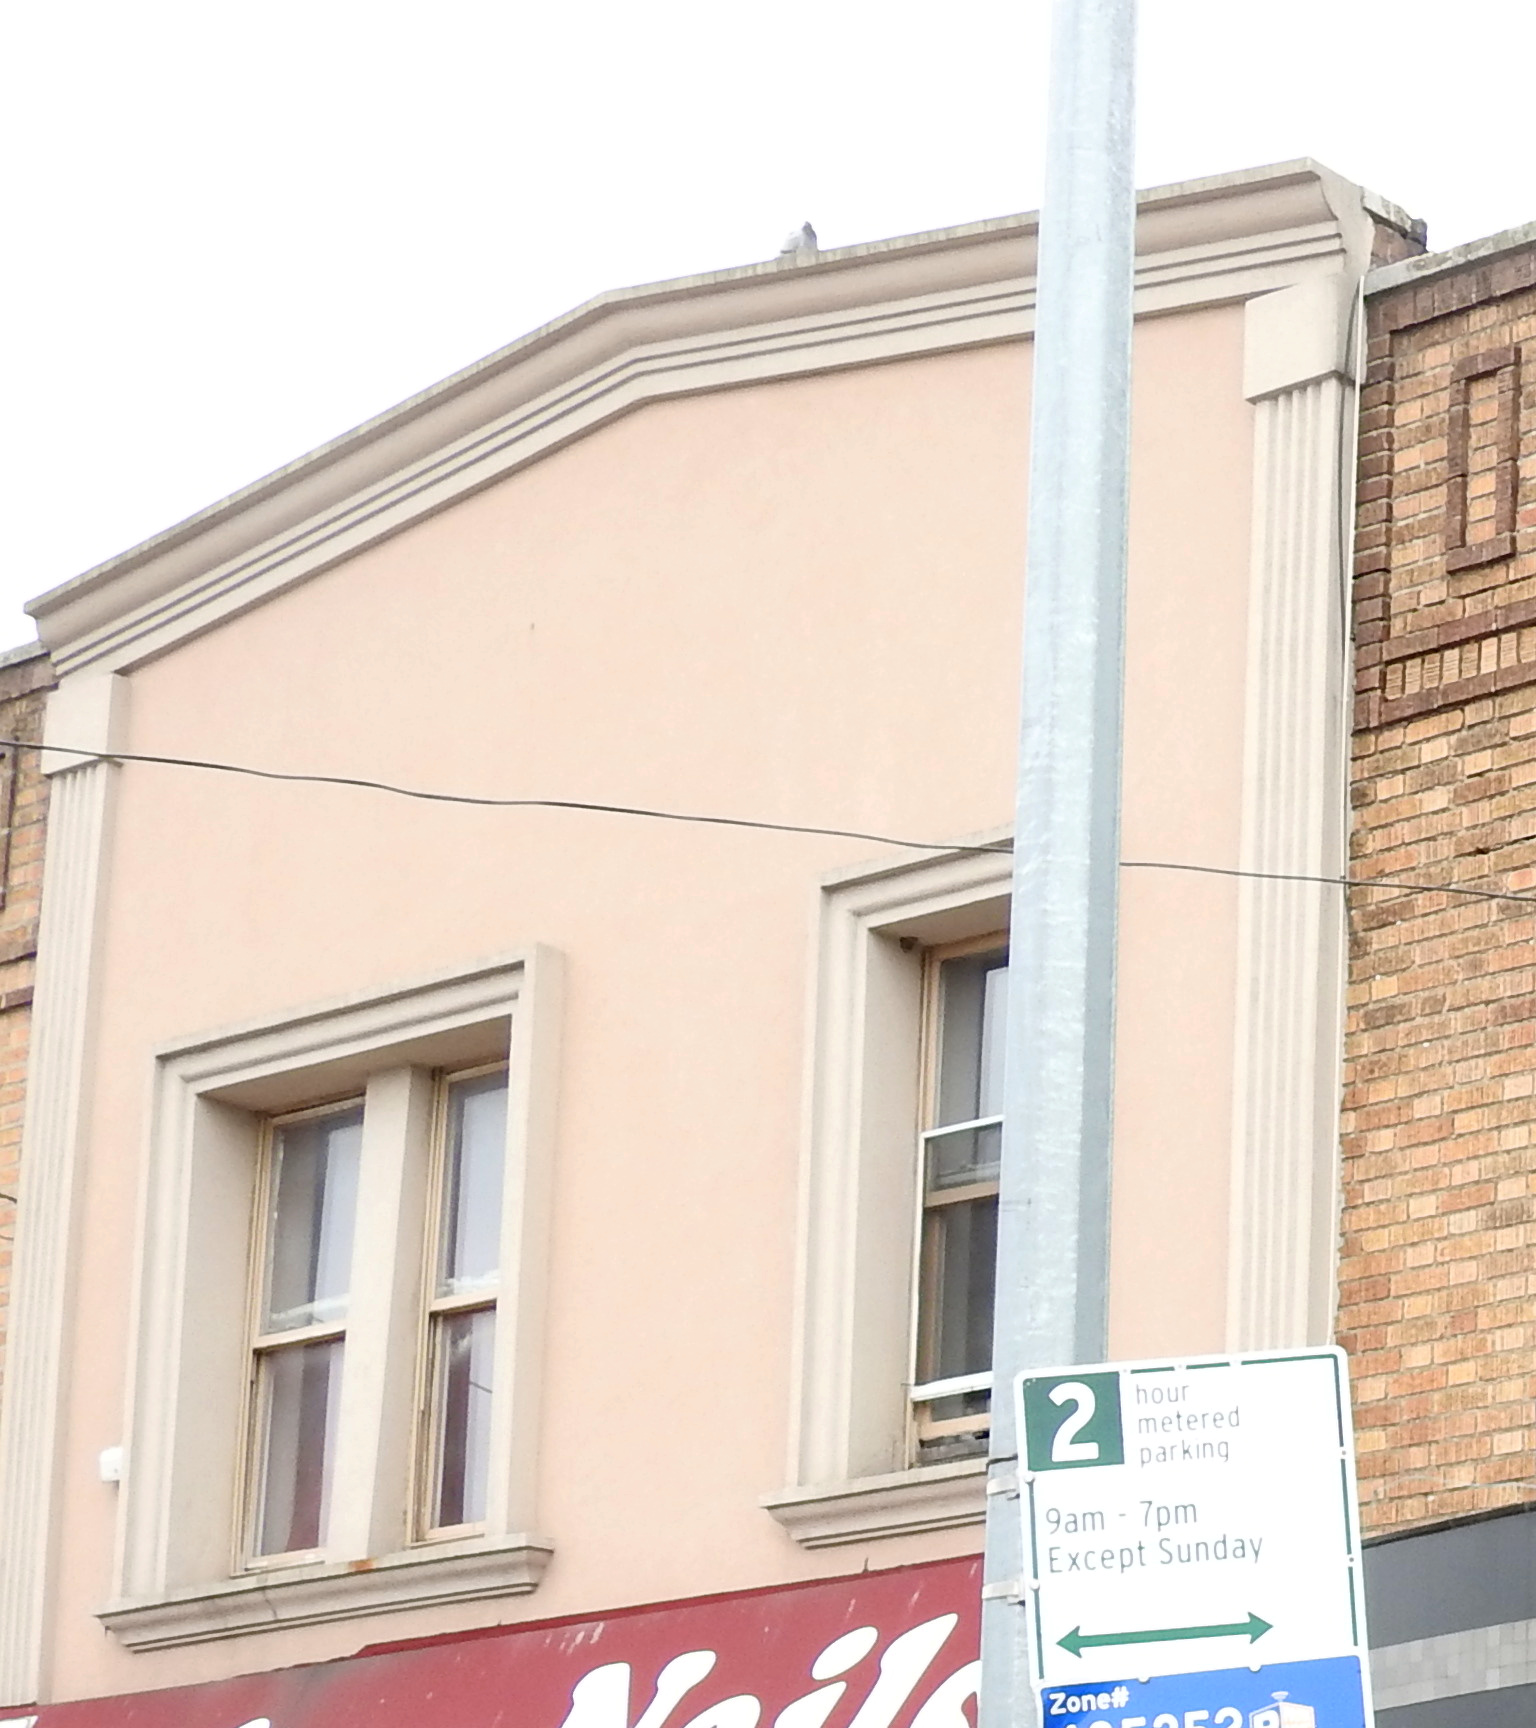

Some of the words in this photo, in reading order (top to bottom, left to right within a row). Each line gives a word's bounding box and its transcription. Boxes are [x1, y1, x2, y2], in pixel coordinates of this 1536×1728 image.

[1048, 1381, 1100, 1462] 2
[1136, 1384, 1190, 1404] hour
[1138, 1406, 1240, 1434] metered
[1139, 1438, 1230, 1467] parking
[1045, 1508, 1105, 1535] 9am
[1139, 1500, 1198, 1531] 7pm
[1048, 1540, 1148, 1573] Except
[1159, 1534, 1263, 1565] Sunday
[1050, 1686, 1130, 1715] Zone#
